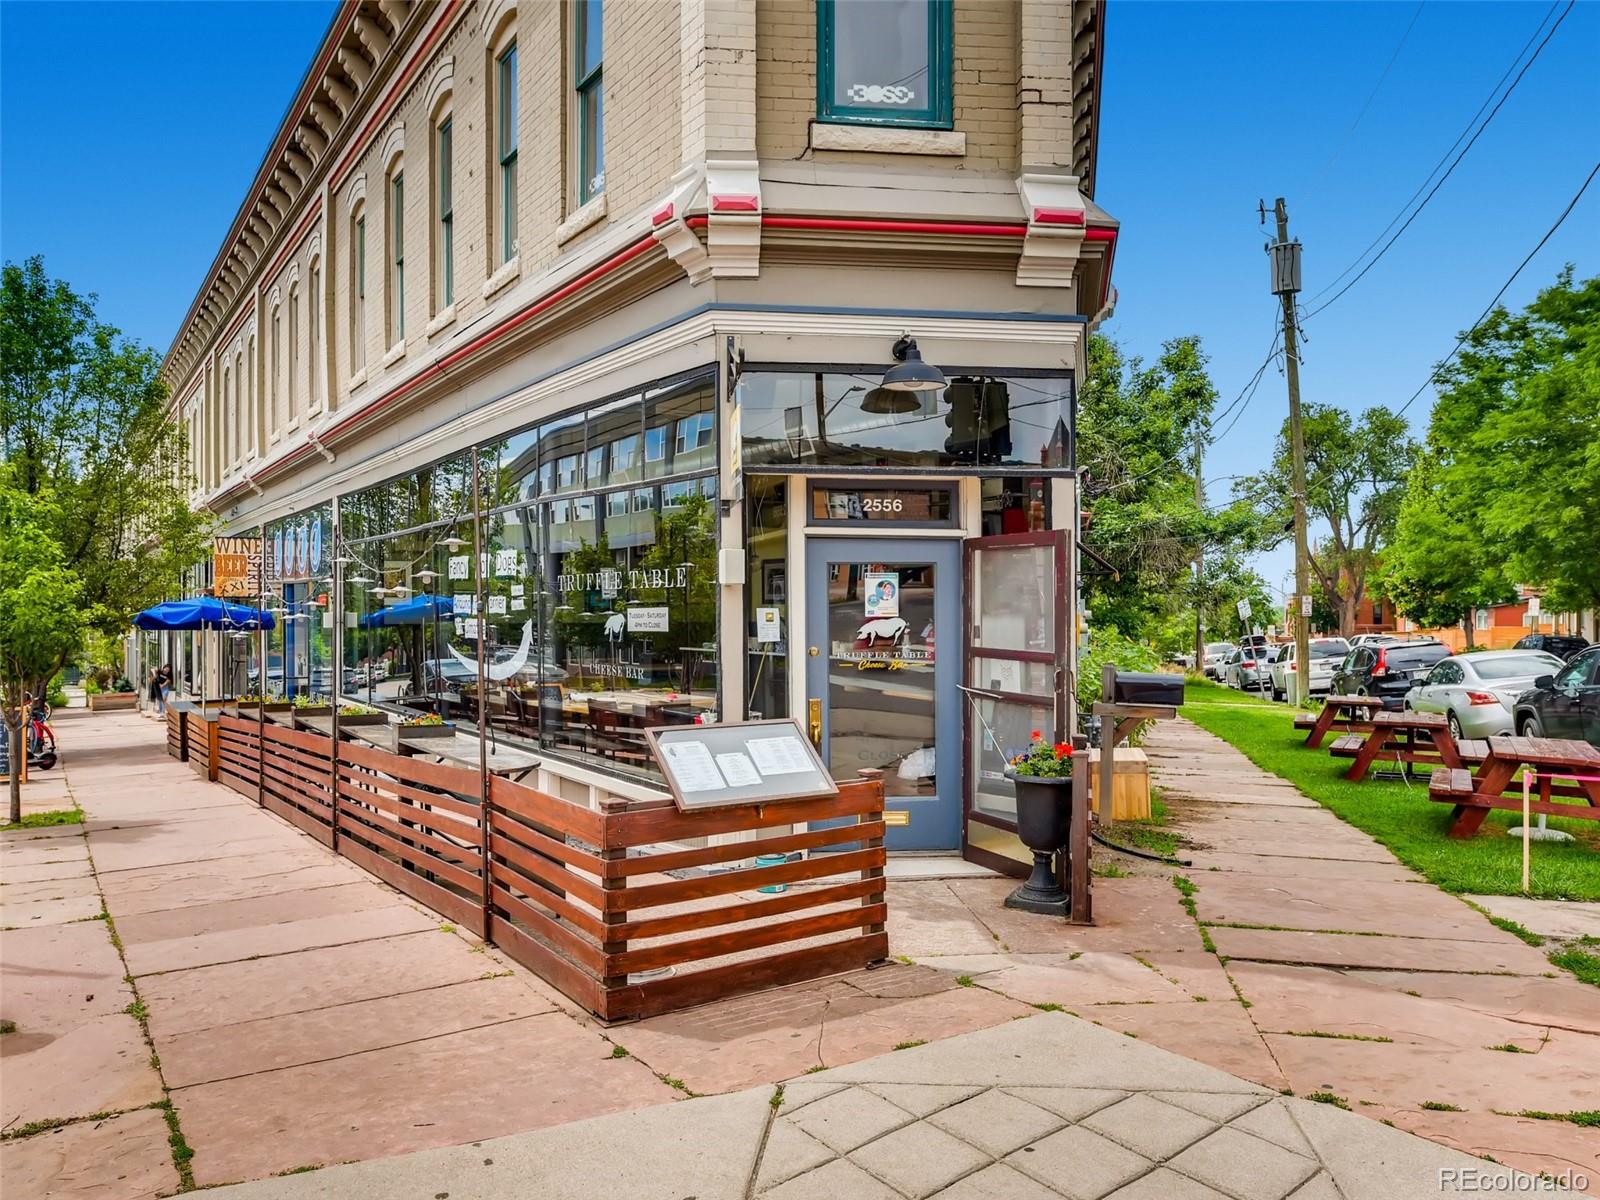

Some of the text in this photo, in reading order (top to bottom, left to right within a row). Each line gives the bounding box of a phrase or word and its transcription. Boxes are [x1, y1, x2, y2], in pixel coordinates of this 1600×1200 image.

[863, 498, 903, 512] 2556
[216, 539, 262, 554] WINE
[215, 554, 247, 577] BEER
[497, 552, 517, 575] Dogs
[247, 555, 261, 599] SPIRITS
[557, 571, 622, 591] TRUFFLE
[629, 567, 686, 589] TABLE
[837, 651, 932, 659] TRUFFLE TABLE
[589, 663, 644, 680] CHEESE BAR
